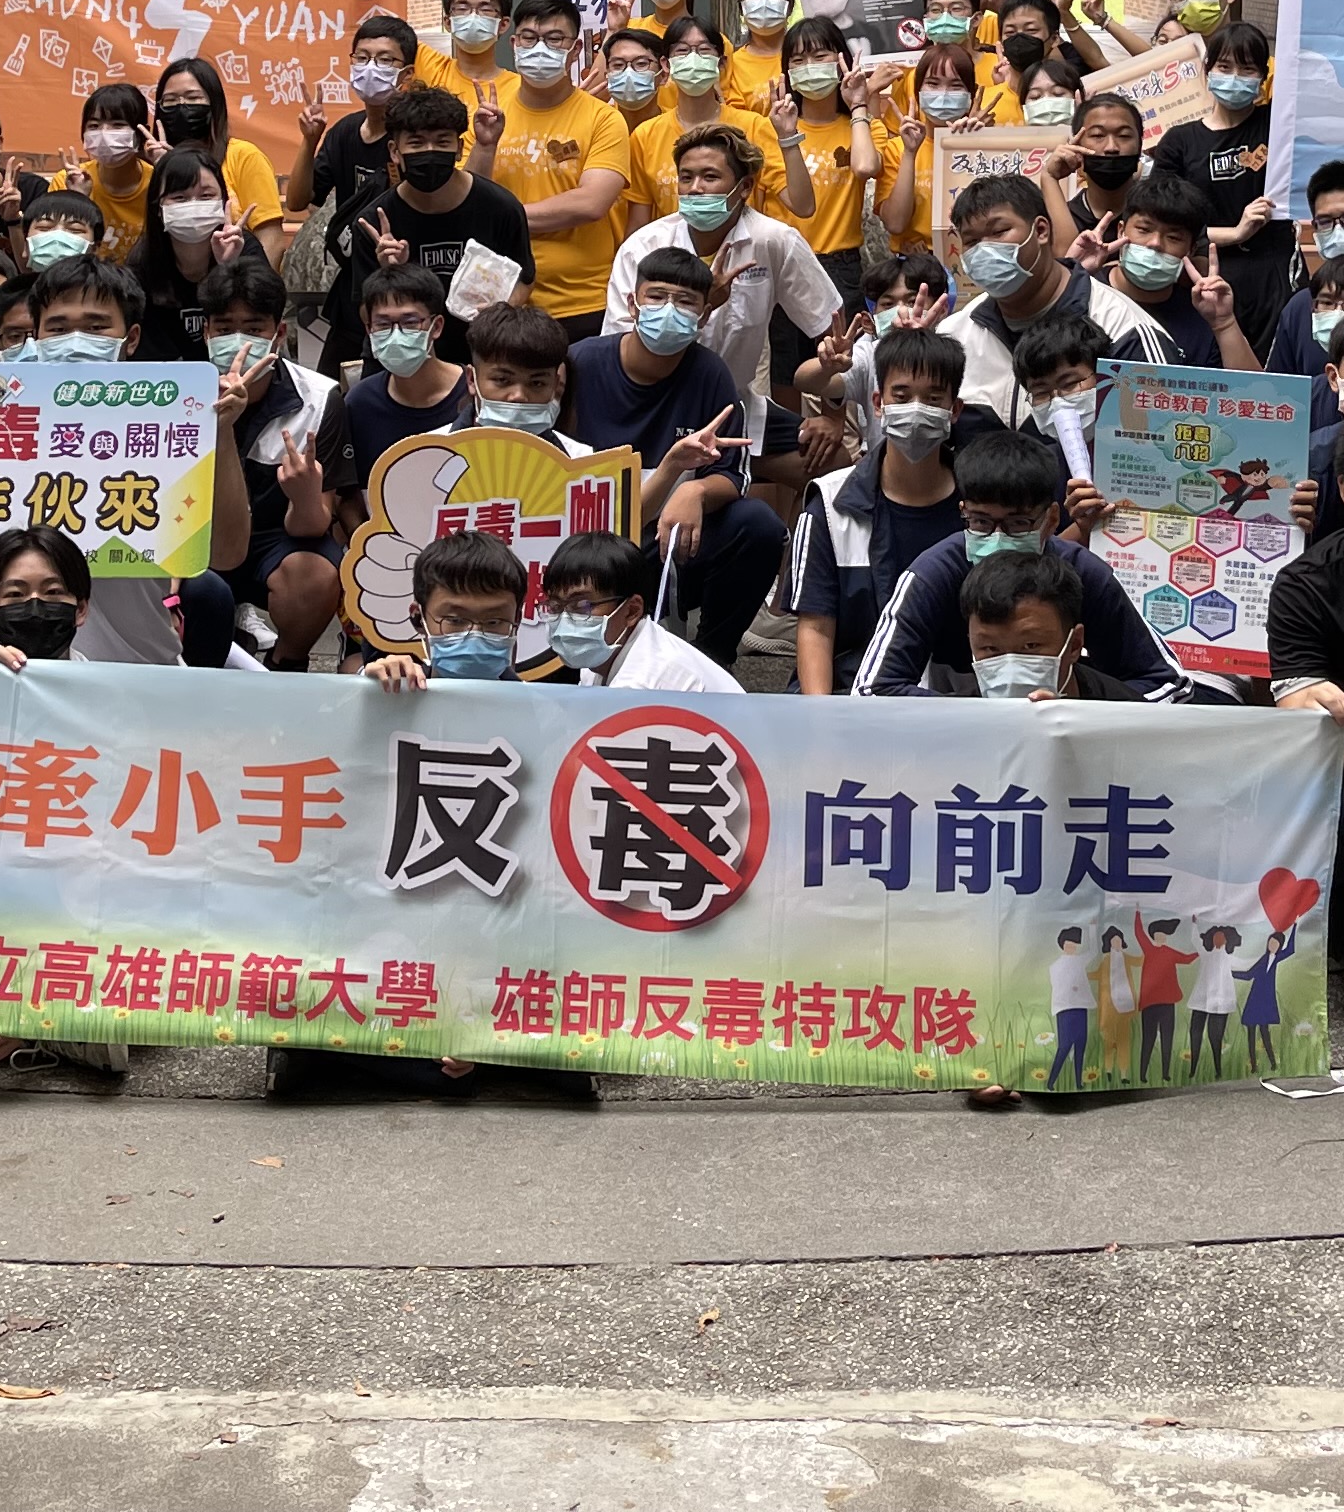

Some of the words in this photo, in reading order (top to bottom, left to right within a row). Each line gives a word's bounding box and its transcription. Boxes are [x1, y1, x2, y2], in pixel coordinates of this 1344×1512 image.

[231, 0, 347, 46] YUAN
[56, 380, 177, 405] 健康新世代
[1134, 390, 1210, 415] 生命教育
[1217, 397, 1296, 421] 珍愛生命
[49, 421, 202, 461] 愛與關懷
[108, 548, 156, 564] 關心您
[803, 778, 1176, 897] 向前走
[490, 965, 979, 1056] 雄師反毒特攻隊
